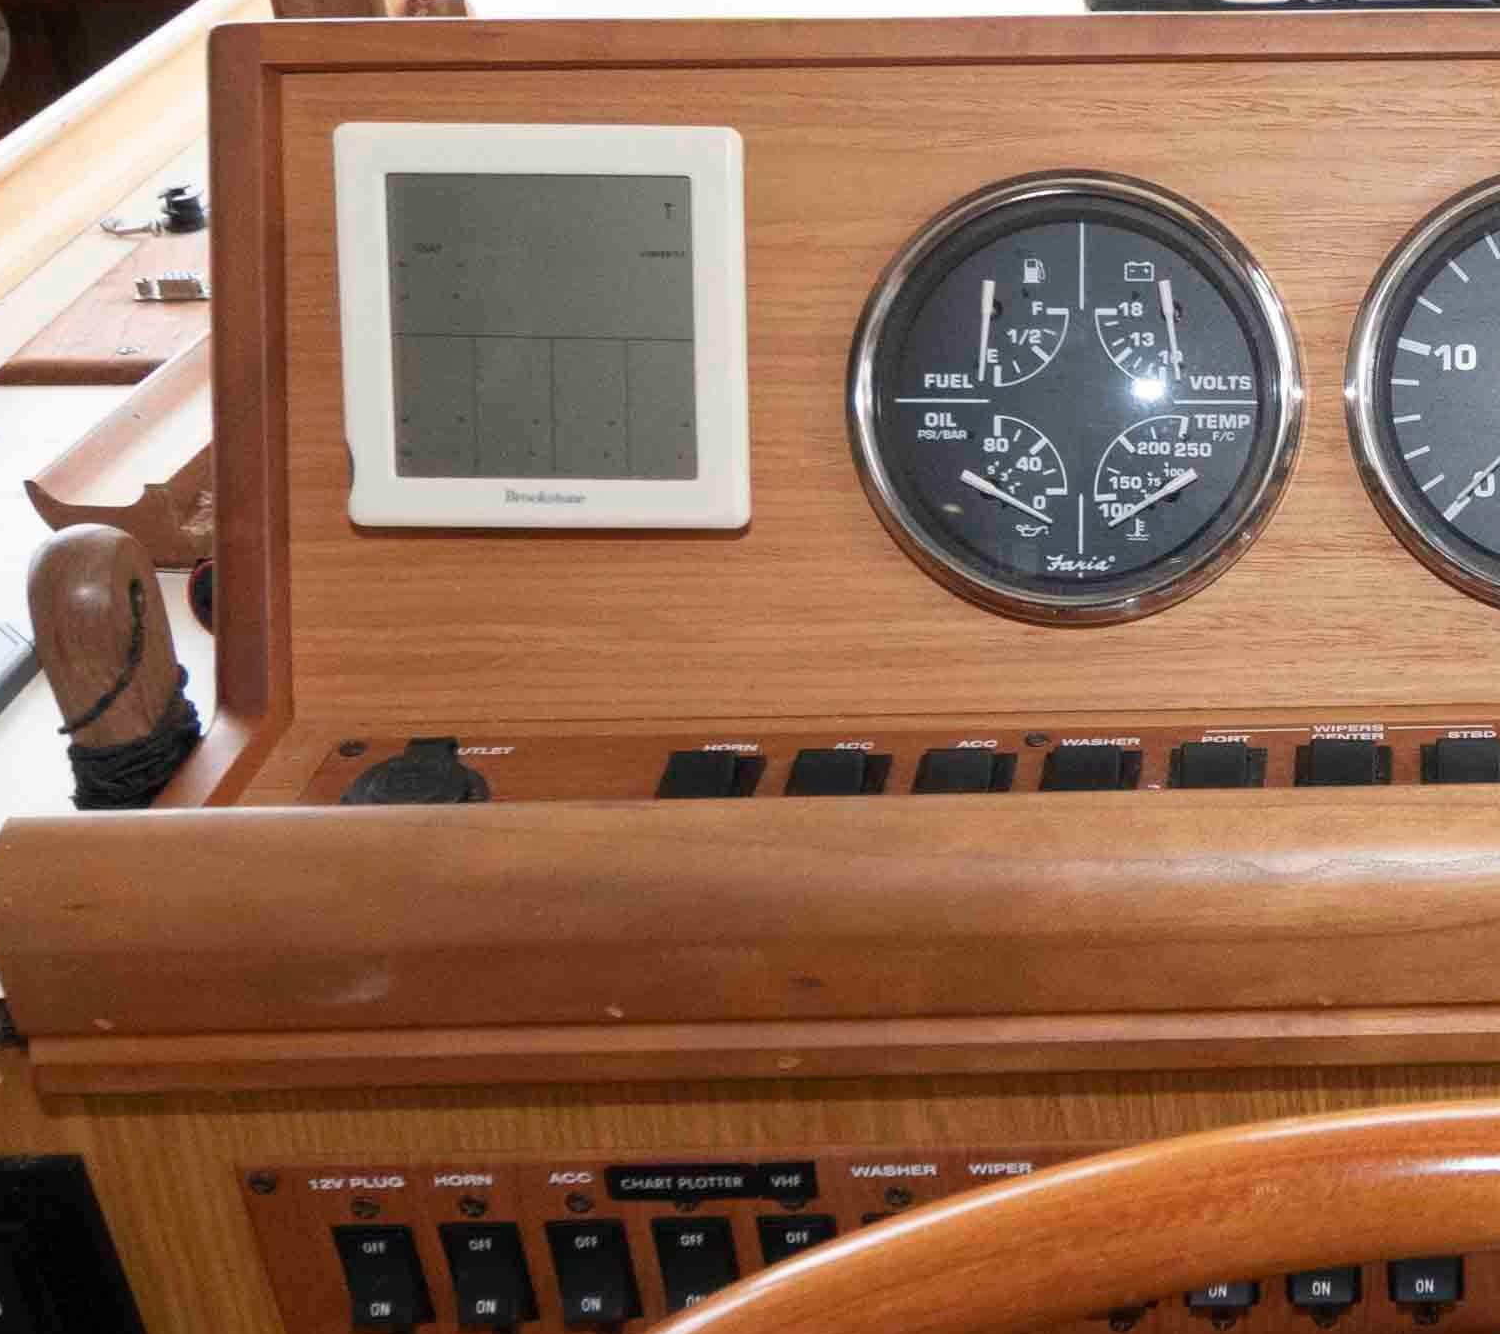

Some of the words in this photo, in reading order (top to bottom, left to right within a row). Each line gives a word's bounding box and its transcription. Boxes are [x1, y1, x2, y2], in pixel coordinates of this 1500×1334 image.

[1031, 302, 1043, 316] F
[1118, 301, 1143, 317] 18
[1006, 329, 1042, 345] 1/2
[1130, 331, 1155, 347] 13
[986, 349, 998, 364] E
[1433, 343, 1477, 372] 10
[924, 373, 973, 390] FUEL
[1189, 376, 1253, 391] VOLTS
[924, 413, 958, 428] OIL
[1194, 415, 1251, 430] TEMP
[917, 430, 969, 441] PSI/BAR
[1212, 430, 1236, 442] F/C
[982, 437, 1010, 454] 80
[1136, 441, 1171, 456] 200
[1173, 442, 1213, 459] 250
[1015, 455, 1042, 472] 40
[1109, 475, 1143, 490] 150
[1472, 471, 1495, 497] 0
[1033, 495, 1046, 511] 0
[1312, 723, 1384, 734] WIPERS
[1448, 730, 1497, 740] STBD
[834, 741, 876, 751] ACC
[956, 739, 998, 749] ACC
[1060, 737, 1141, 748] WASHER
[1201, 734, 1251, 744] PORT
[704, 743, 759, 753] HORN
[850, 1164, 938, 1179] WASHER
[968, 1162, 1033, 1175] WIPER
[309, 1177, 346, 1190] 12V
[350, 1176, 405, 1189] PLUG
[433, 1173, 493, 1187] HORN
[549, 1171, 592, 1185] ACC
[620, 1176, 673, 1190] CHART
[676, 1175, 744, 1189] PLOTTER
[770, 1173, 802, 1188] VHF
[468, 1237, 494, 1252] OFF
[574, 1235, 600, 1249] OFF
[679, 1233, 706, 1247] OFF
[785, 1230, 810, 1245] OFF
[362, 1240, 388, 1254] OFF
[1207, 1282, 1229, 1298] ON
[1311, 1280, 1333, 1297] ON
[1414, 1278, 1437, 1295] ON
[369, 1302, 392, 1317] ON
[475, 1300, 498, 1315] ON
[581, 1298, 603, 1313] ON
